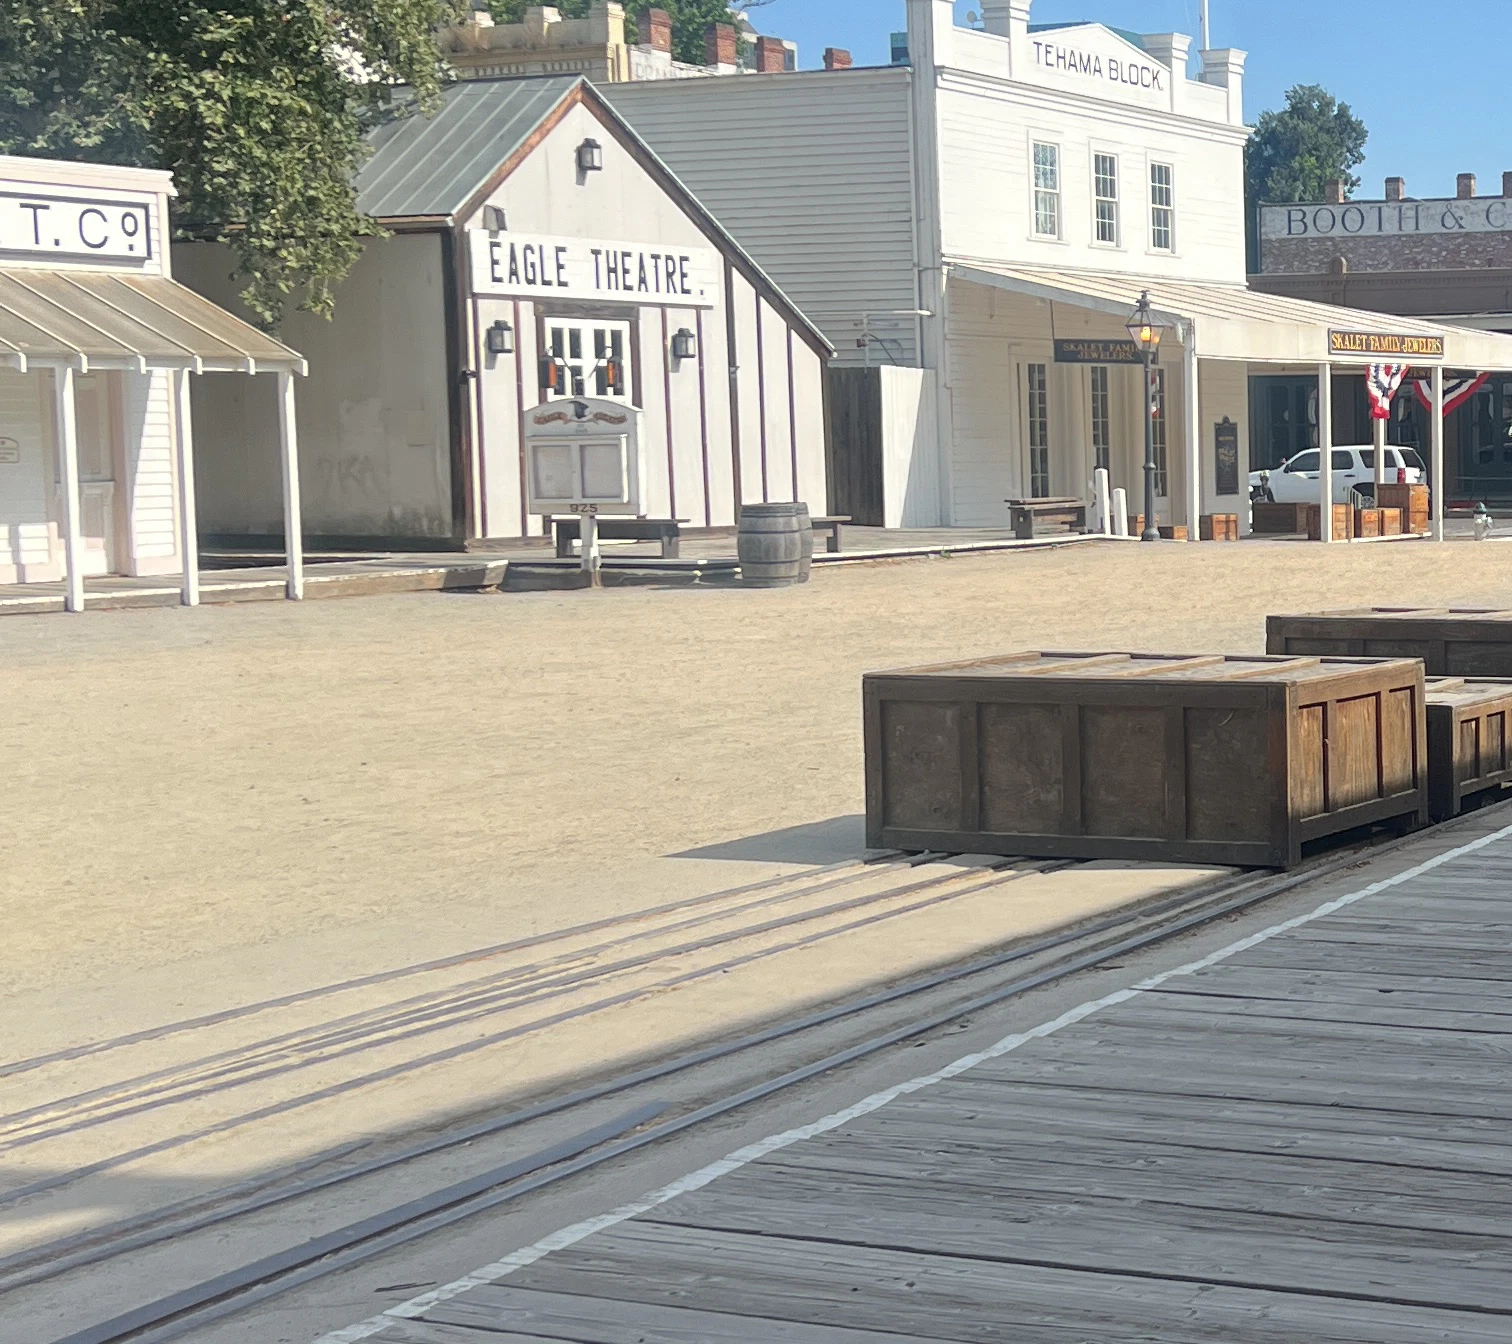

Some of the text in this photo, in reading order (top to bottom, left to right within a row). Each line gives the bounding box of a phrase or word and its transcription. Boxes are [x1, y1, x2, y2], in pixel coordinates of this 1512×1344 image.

[1033, 41, 1103, 78] TEHAMA
[1286, 204, 1421, 236] BOOTH
[1440, 202, 1466, 230] &
[489, 241, 569, 287] EAGLE
[1063, 342, 1104, 353] SKALET
[1331, 333, 1368, 351] SKALET
[1369, 335, 1402, 352] FAMILY
[569, 503, 598, 513] 925
